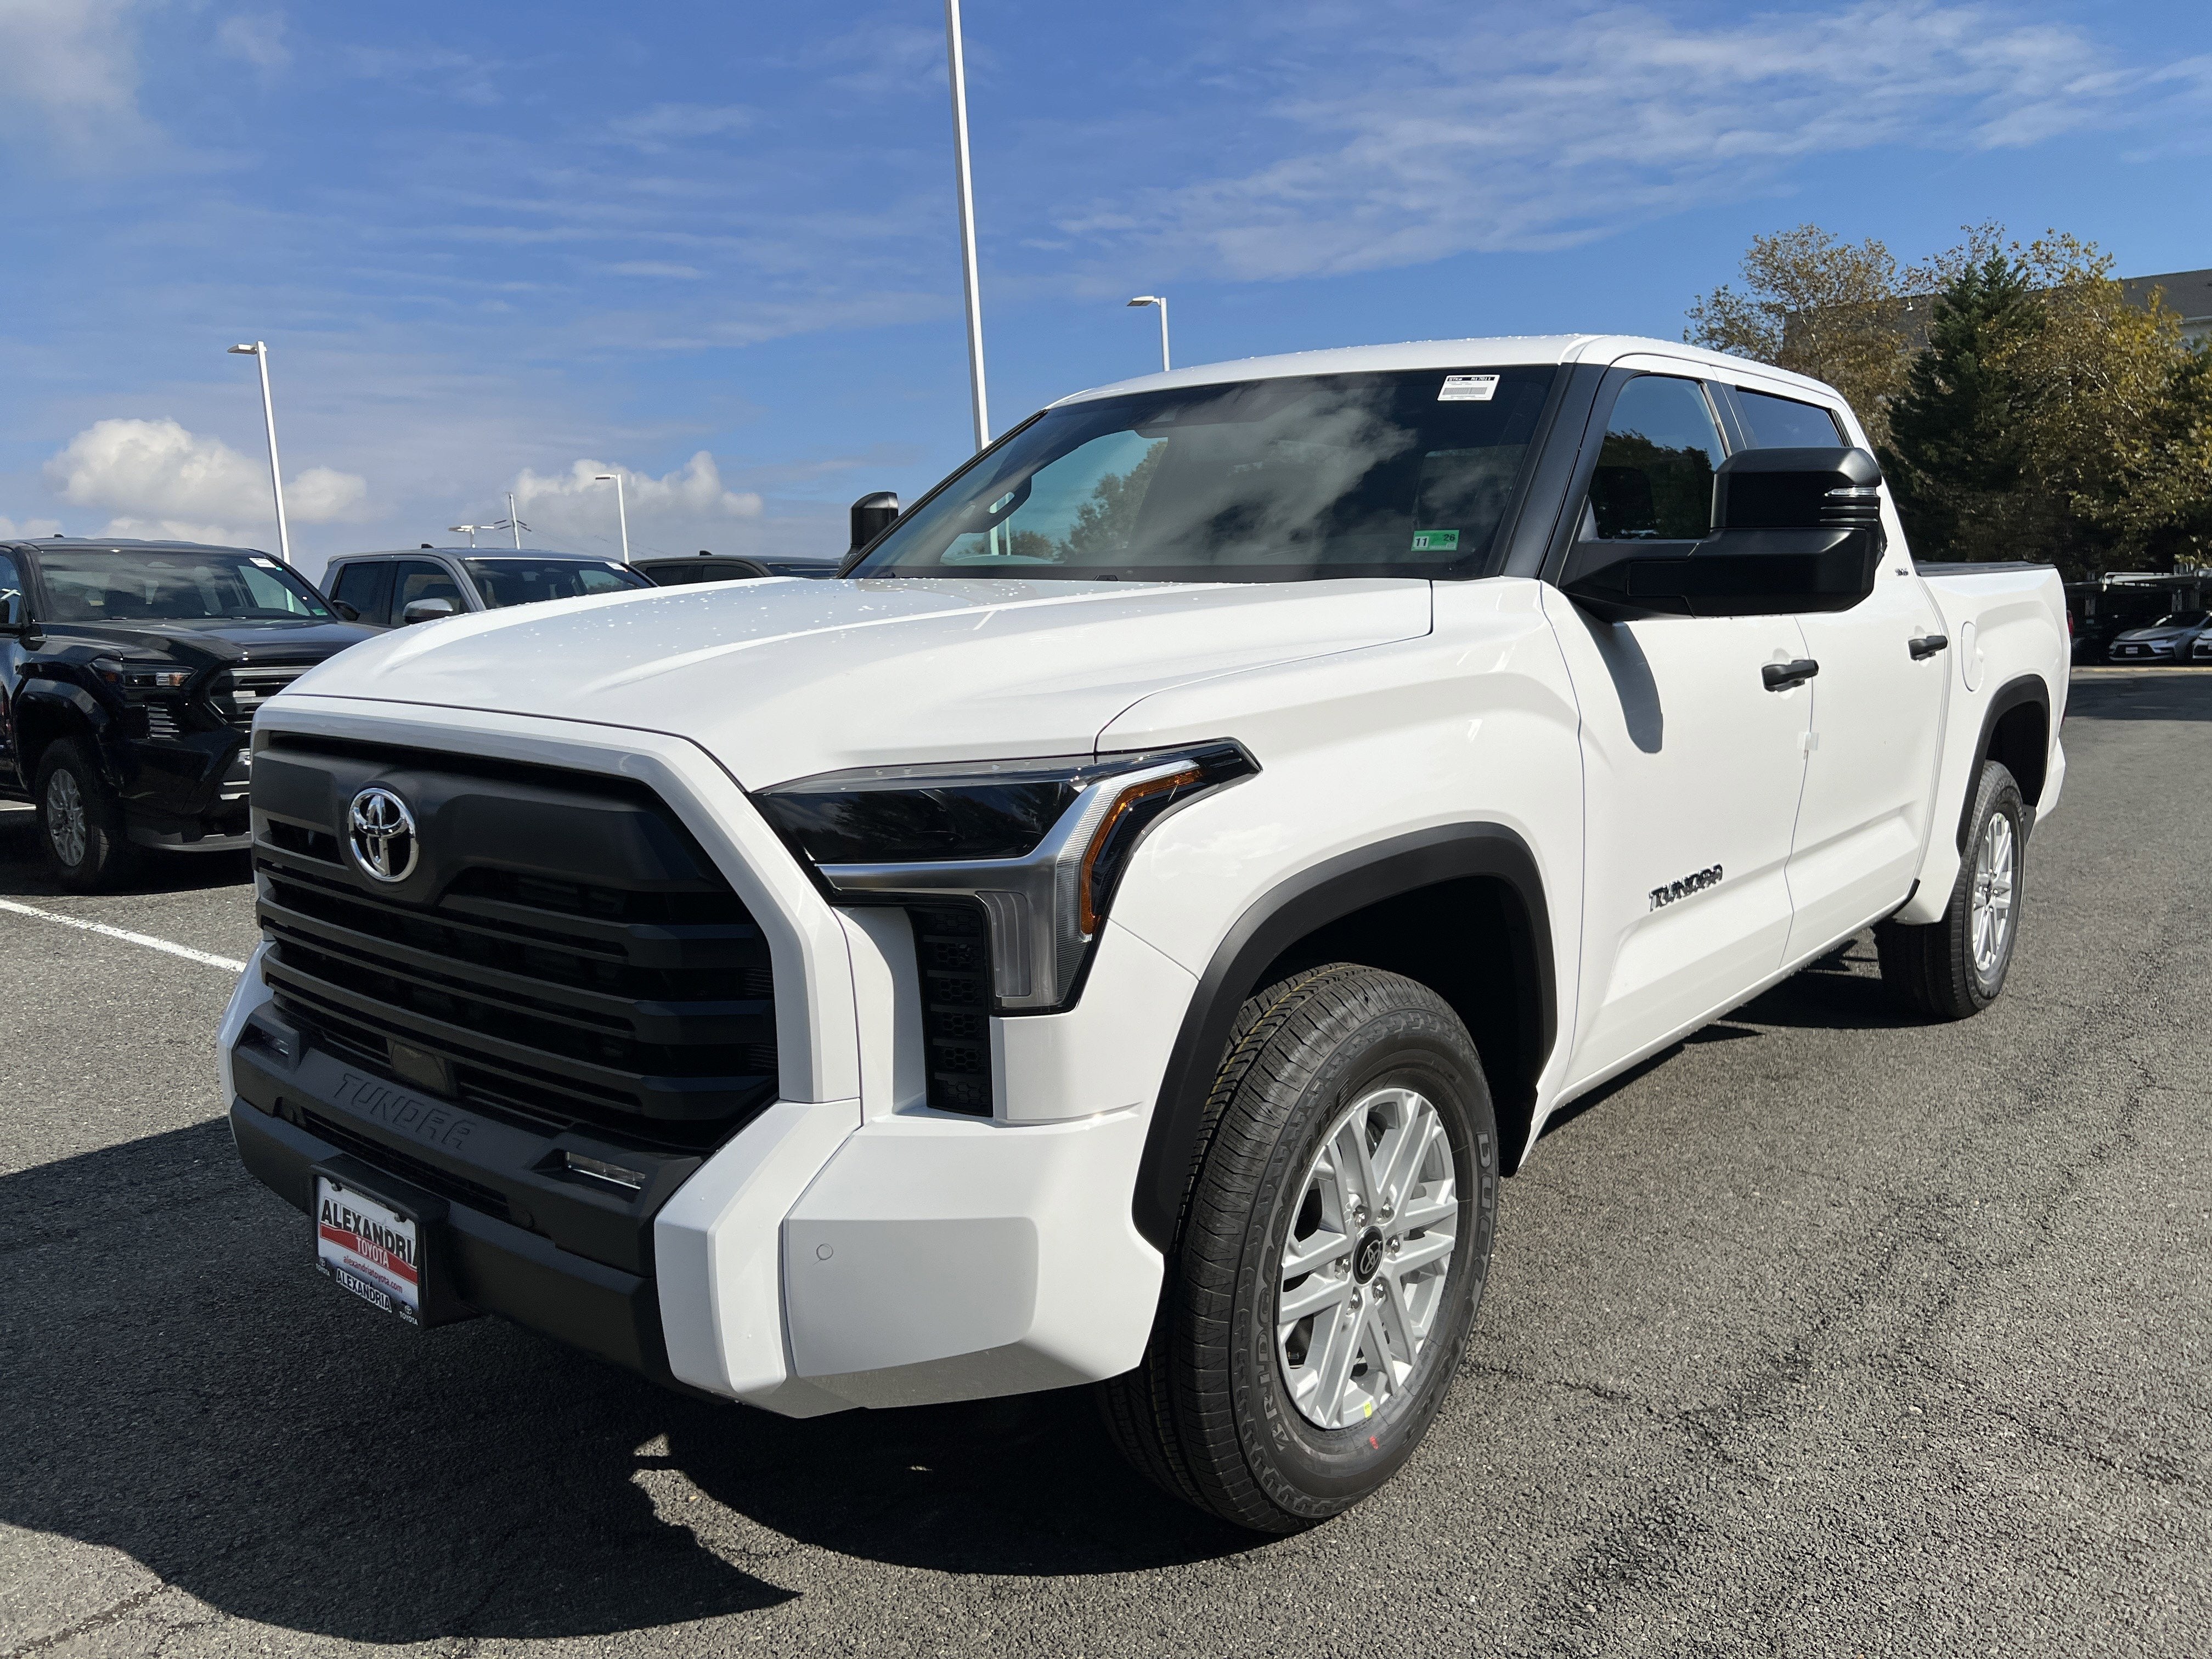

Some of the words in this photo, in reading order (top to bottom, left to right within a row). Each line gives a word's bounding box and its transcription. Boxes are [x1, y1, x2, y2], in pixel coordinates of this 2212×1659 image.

[1415, 538, 1427, 546] 11
[1649, 864, 1723, 912] TUNDRA
[333, 1073, 477, 1150] TUNDRA
[356, 1237, 390, 1268] TOYOTA
[336, 1268, 392, 1313] ALEXANDRIA
[343, 1255, 403, 1294] alexandriatoyota.com
[399, 1311, 419, 1325] TOYOTA
